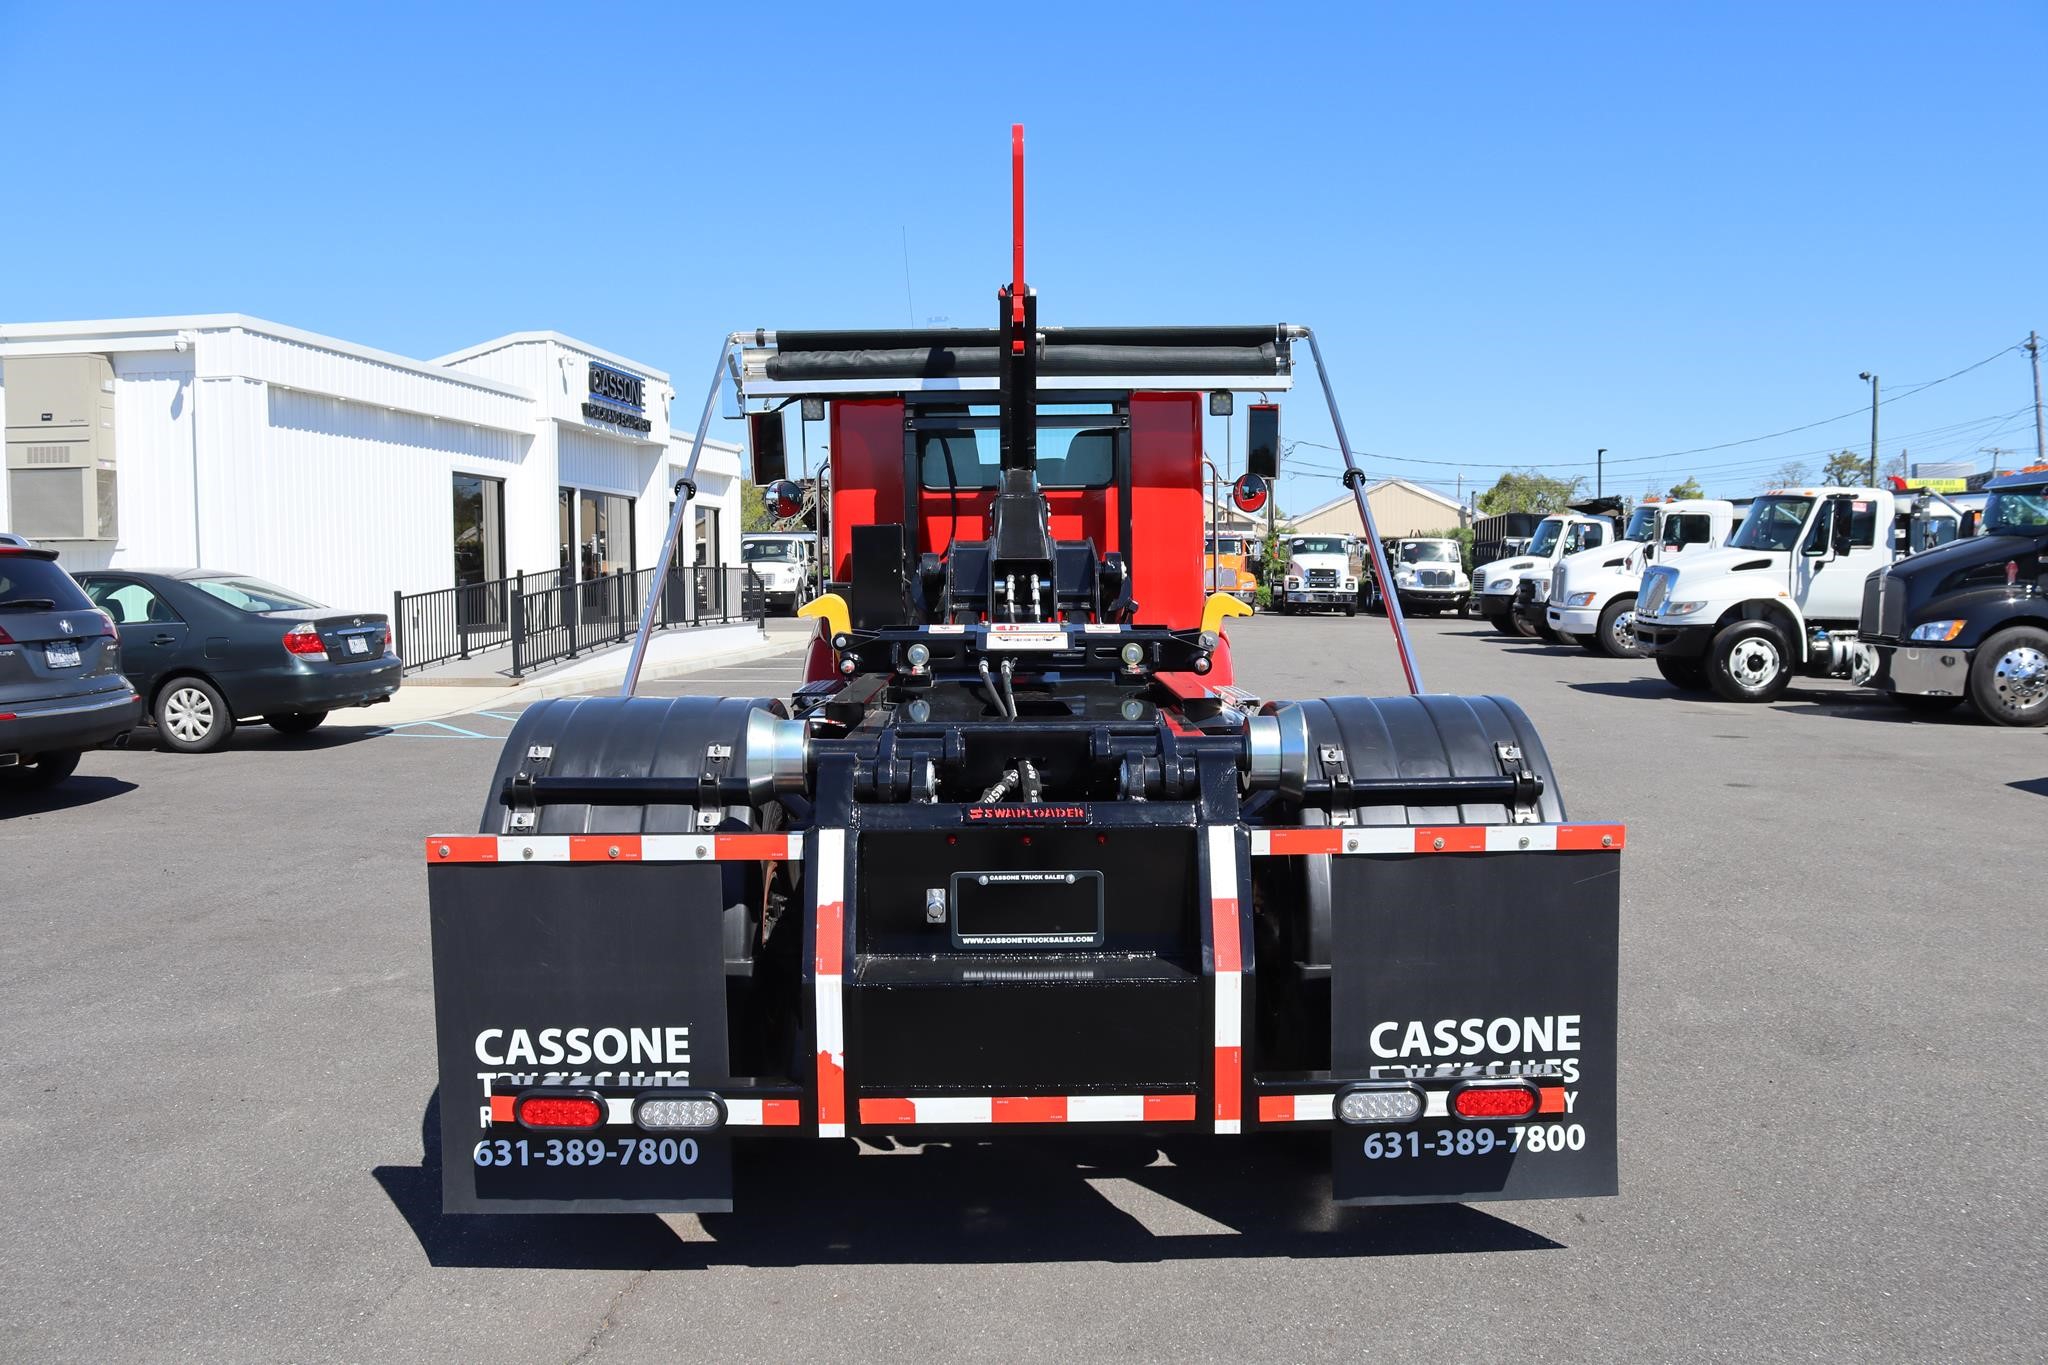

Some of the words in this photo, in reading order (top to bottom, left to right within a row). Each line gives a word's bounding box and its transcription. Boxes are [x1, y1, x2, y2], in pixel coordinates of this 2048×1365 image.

[984, 808, 1085, 818] SWAPLOADER
[962, 936, 1094, 944] WWW.CASSONETRUCKSALES.COM
[475, 1027, 691, 1065] CASSONE
[1369, 1015, 1581, 1058] CASSONE
[473, 1138, 699, 1167] 631-389-7800
[1363, 1124, 1586, 1160] 631-389-7800
